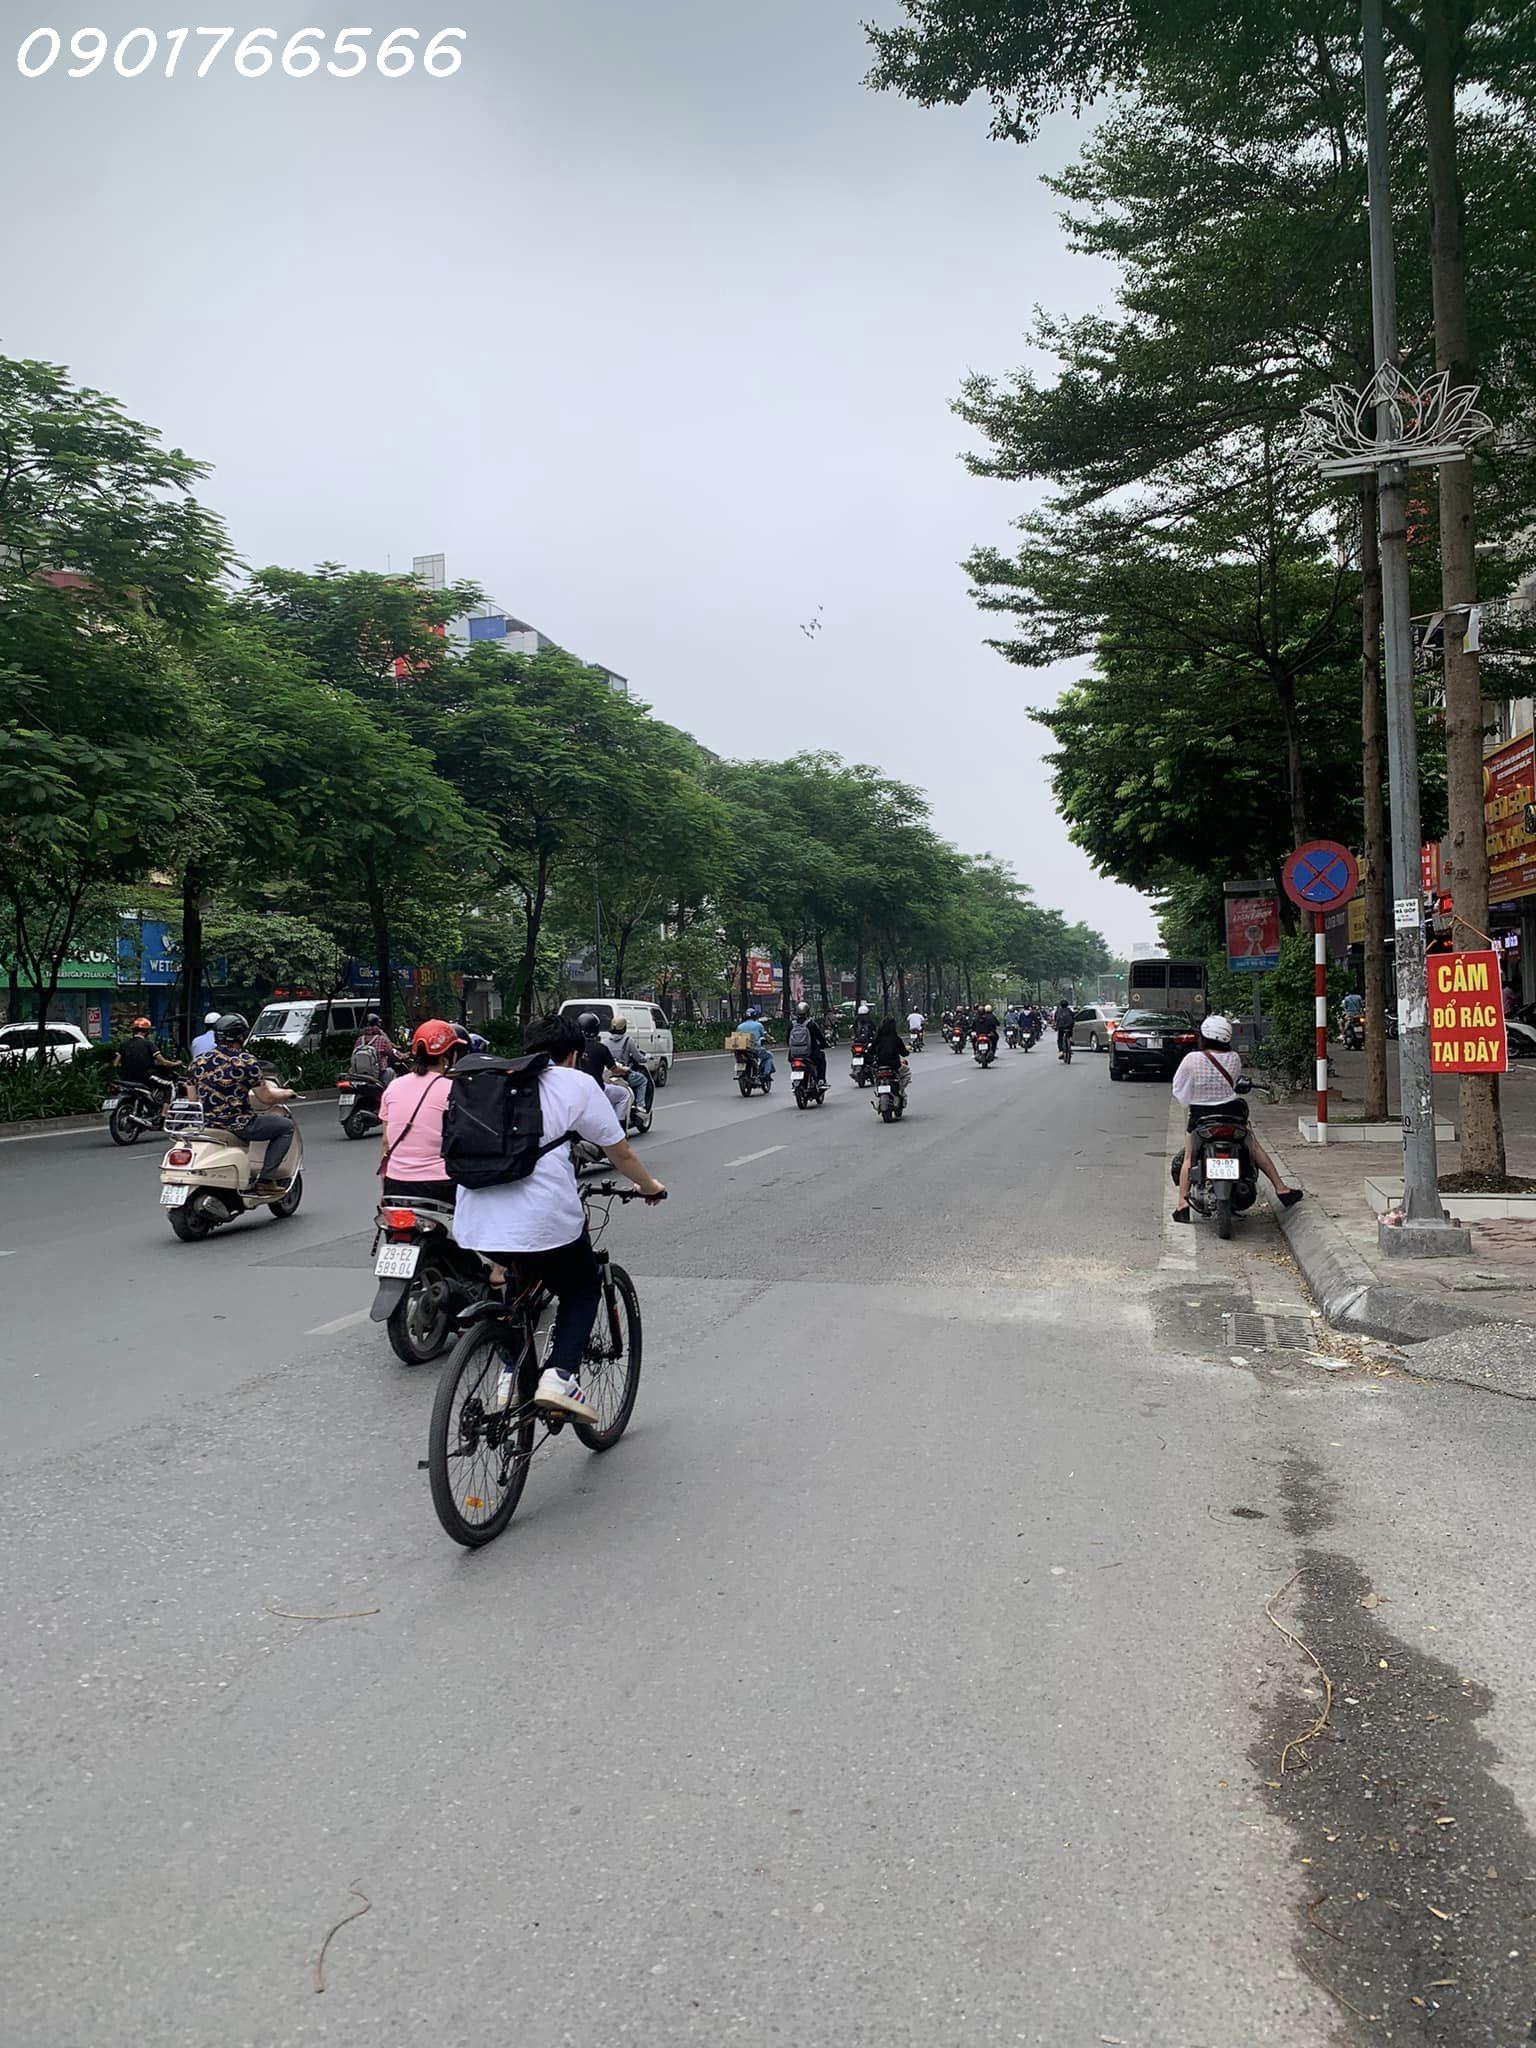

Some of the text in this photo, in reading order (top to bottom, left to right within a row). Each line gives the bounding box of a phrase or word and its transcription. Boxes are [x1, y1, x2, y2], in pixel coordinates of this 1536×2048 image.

[1438, 954, 1489, 993] CẤM
[1433, 999, 1497, 1028] ĐỔ RÁC
[1432, 1036, 1500, 1067] TẠI ĐÂY
